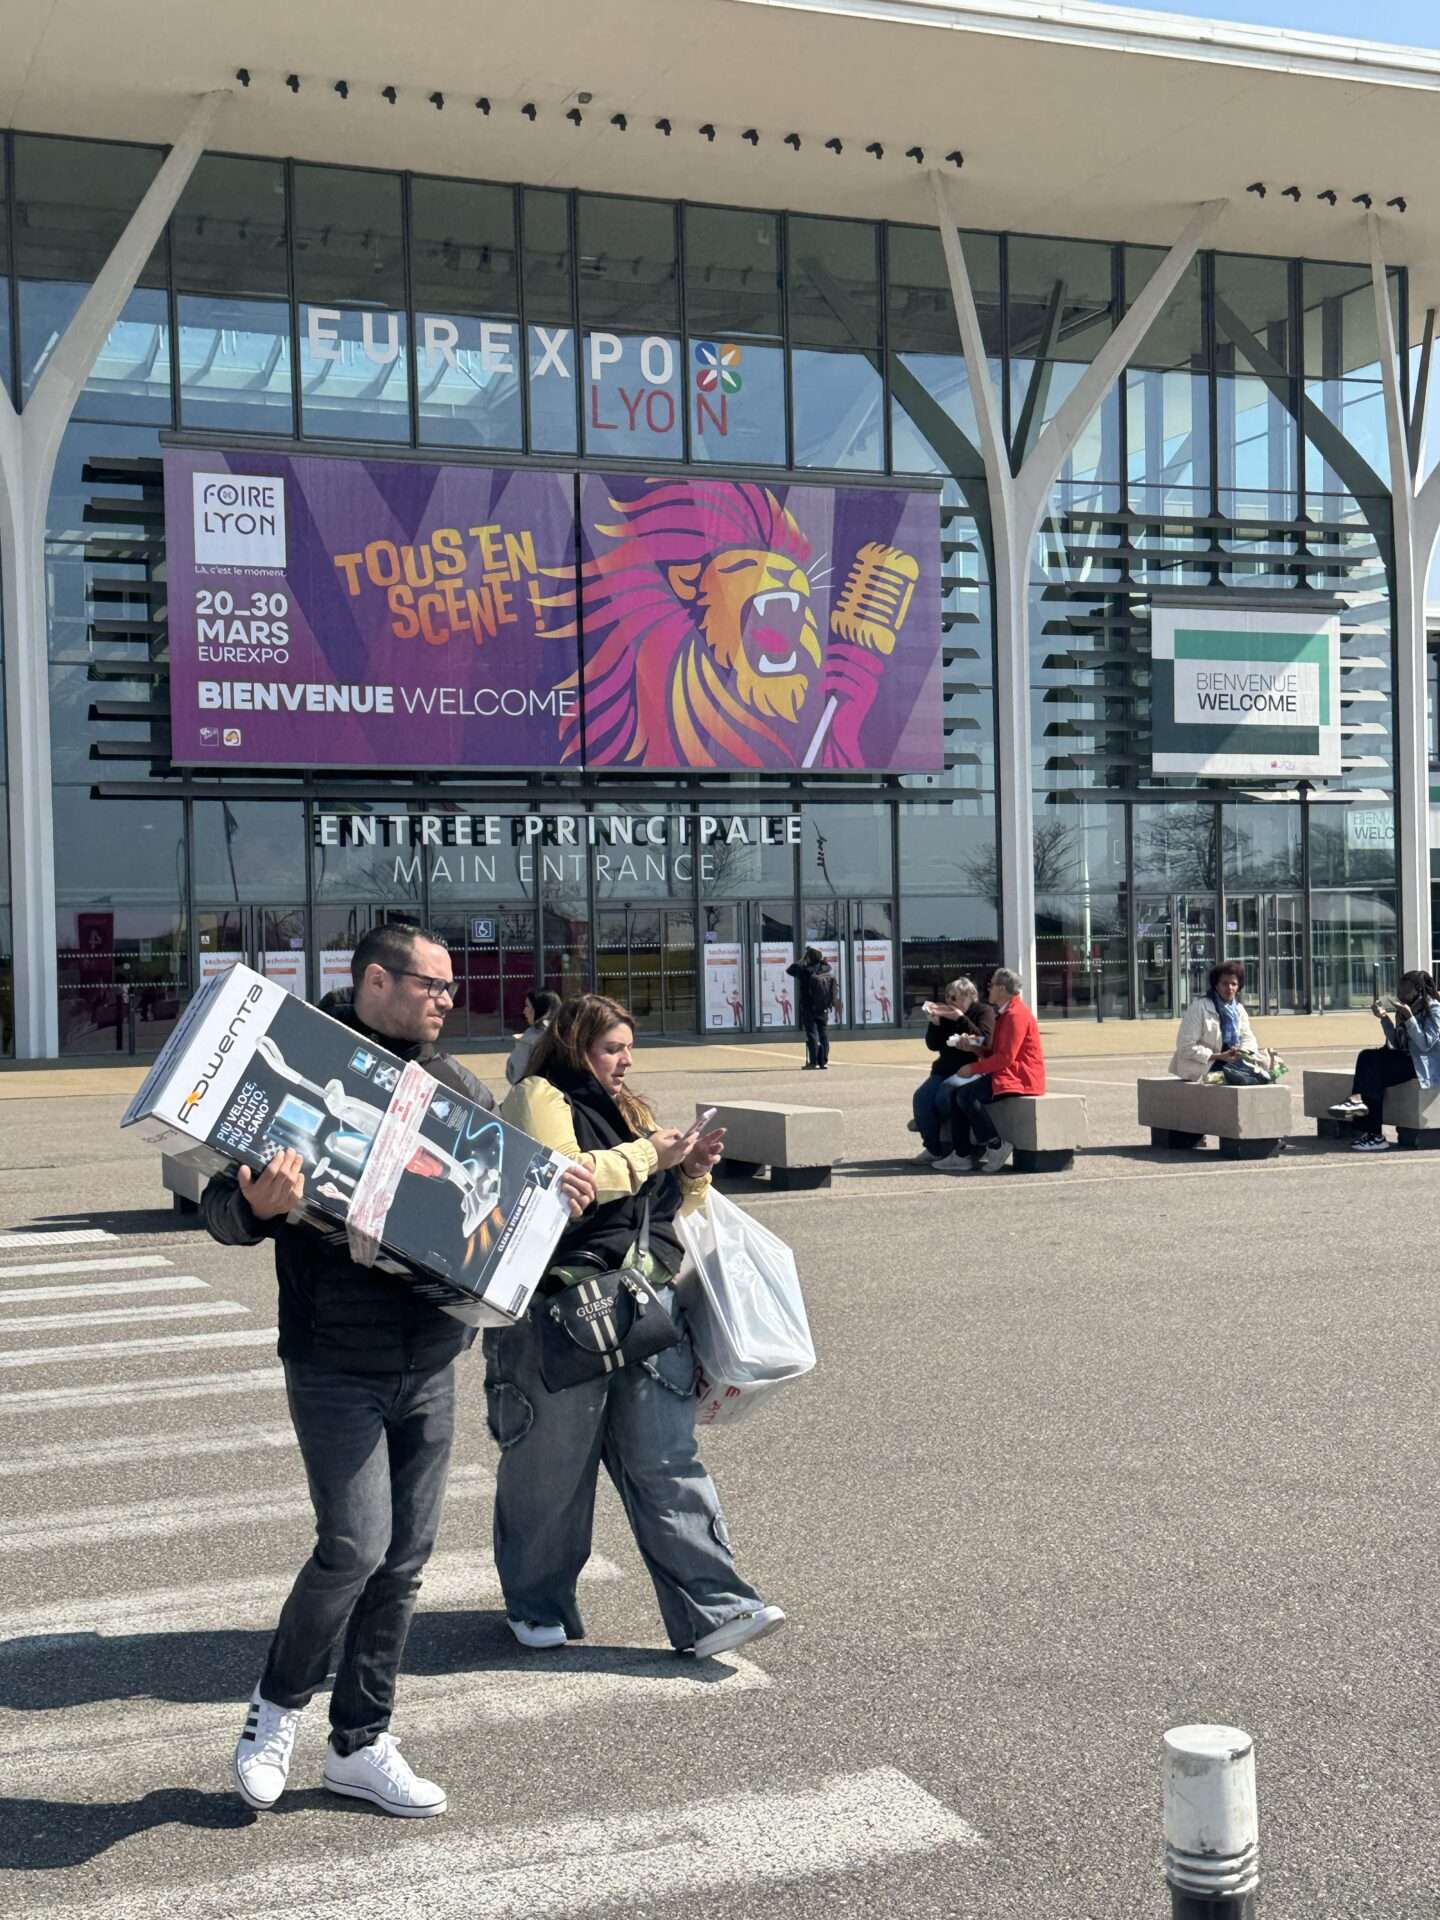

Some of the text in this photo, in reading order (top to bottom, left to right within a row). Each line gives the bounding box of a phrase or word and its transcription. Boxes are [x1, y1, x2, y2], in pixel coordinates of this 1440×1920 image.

[307, 307, 673, 385] EUREXPO
[591, 385, 728, 437] LYON
[203, 483, 275, 508] FOIRE
[204, 511, 275, 536] LYON
[233, 566, 242, 575] le
[334, 524, 538, 596] TOUS EN
[195, 589, 289, 617] 20_30
[197, 618, 289, 646] MARS
[198, 646, 289, 664] EUREXPO
[1196, 672, 1297, 693] BIENVENUE
[197, 680, 577, 717] BIENVENUE WELCOME
[1197, 693, 1297, 712] WELCOME
[320, 815, 801, 845] ENTREE PRINCIPALE
[1353, 811, 1395, 825] BIENV
[393, 854, 715, 883] MAIN ENTRANCE
[227, 1081, 257, 1121] VELOCE,
[237, 1090, 267, 1129] PULITO,
[576, 1296, 615, 1318] GUESS
